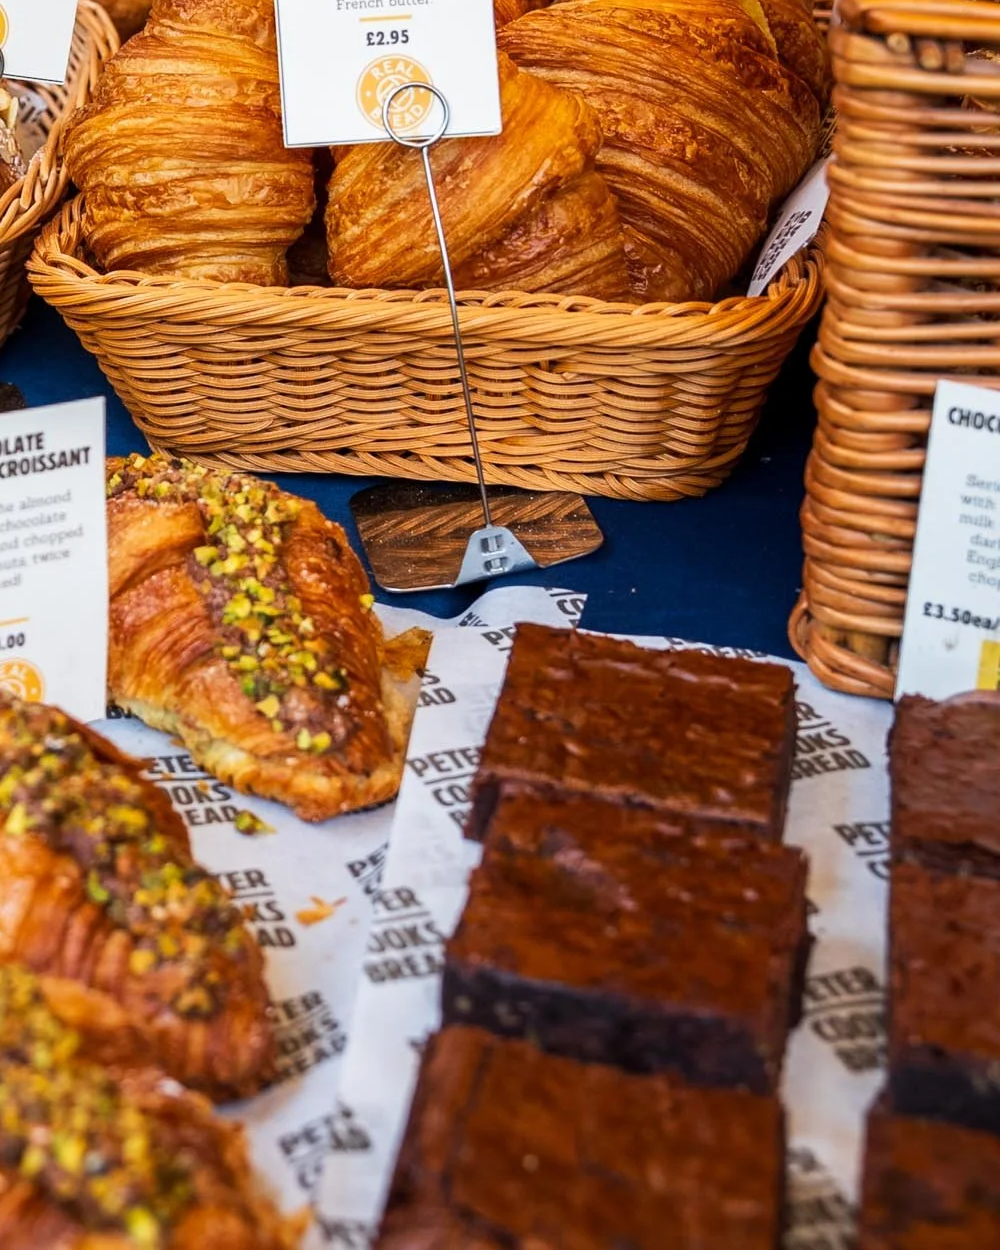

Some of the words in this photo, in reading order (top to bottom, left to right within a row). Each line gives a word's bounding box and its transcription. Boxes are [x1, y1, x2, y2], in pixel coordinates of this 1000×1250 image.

[367, 30, 409, 46] £2.95
[371, 61, 414, 79] REAL
[369, 104, 423, 127] BEAD
[947, 406, 1000, 434] CHOC
[148, 754, 199, 775] ETE
[407, 746, 481, 777] PETE
[184, 805, 239, 825] EAD
